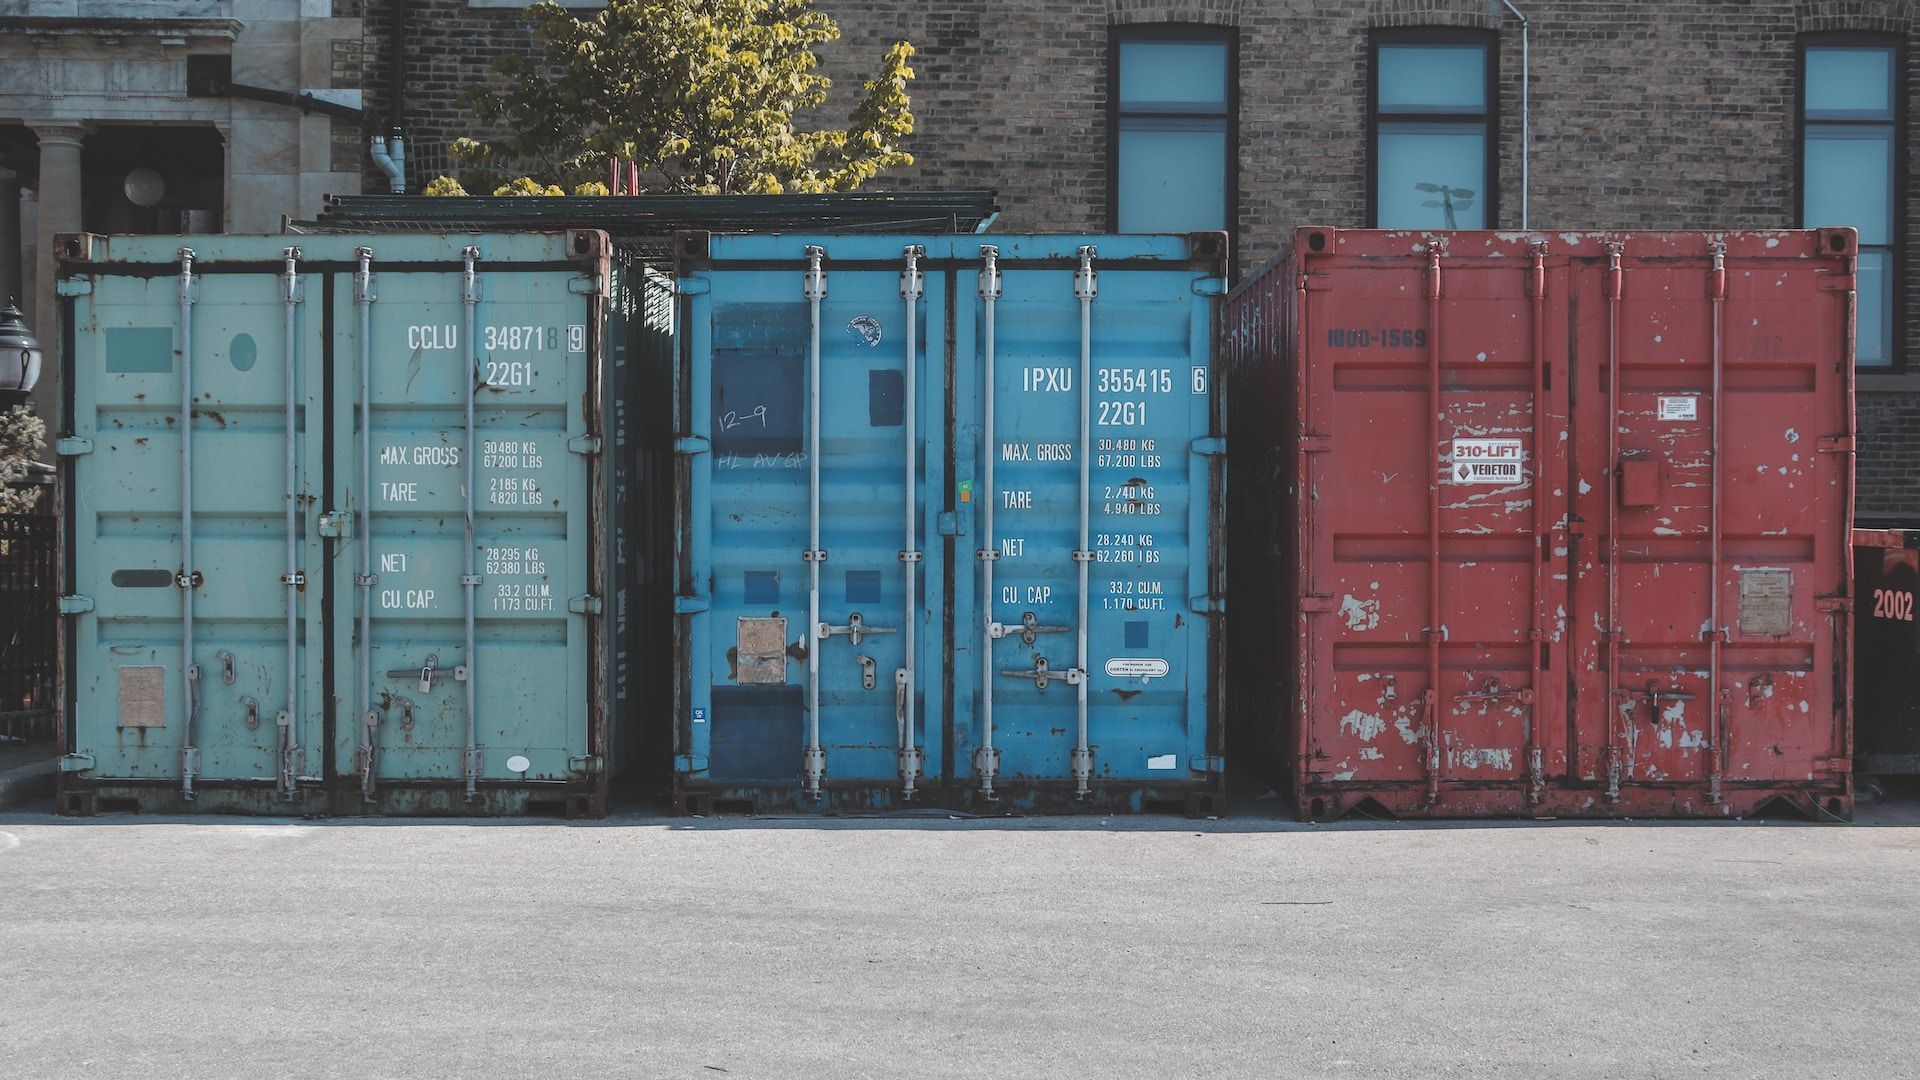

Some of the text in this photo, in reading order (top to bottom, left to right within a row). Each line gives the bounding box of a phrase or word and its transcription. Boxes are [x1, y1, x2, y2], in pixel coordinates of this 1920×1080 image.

[408, 325, 457, 349] CCLU
[571, 327, 583, 350] 9
[487, 362, 531, 386] 22G1
[1023, 368, 1206, 392] IPXU 355415 6
[719, 406, 766, 432] 12-9
[1098, 402, 1146, 426] 22G1
[523, 442, 536, 454] KG
[1099, 440, 1154, 451] 30.480 KG
[1456, 446, 1519, 457] 310-LIFT
[381, 447, 458, 465] MAX. GROSS
[1003, 444, 1072, 461] MAX. GROSS
[523, 456, 542, 468] LBS
[1099, 455, 1161, 468] 67.200 LBS
[1472, 464, 1516, 475] VENETOR
[523, 479, 535, 490] KG
[381, 483, 417, 501] TARE
[523, 493, 542, 504] LBS
[1003, 491, 1032, 509] TARE
[1104, 503, 1160, 514] 4.940 LBS
[1097, 534, 1152, 546] 28.240 KG
[1002, 539, 1024, 556] NET
[525, 549, 538, 560] KG
[1097, 550, 1134, 563] 62.260
[525, 562, 544, 574] LBS
[498, 585, 519, 597] 33.2
[1003, 586, 1053, 603] CU. CAP.
[1110, 582, 1133, 594] 33.2
[382, 590, 438, 608] CU. CAP.
[1103, 598, 1133, 609] 1.170
[1874, 588, 1913, 621] 2002
